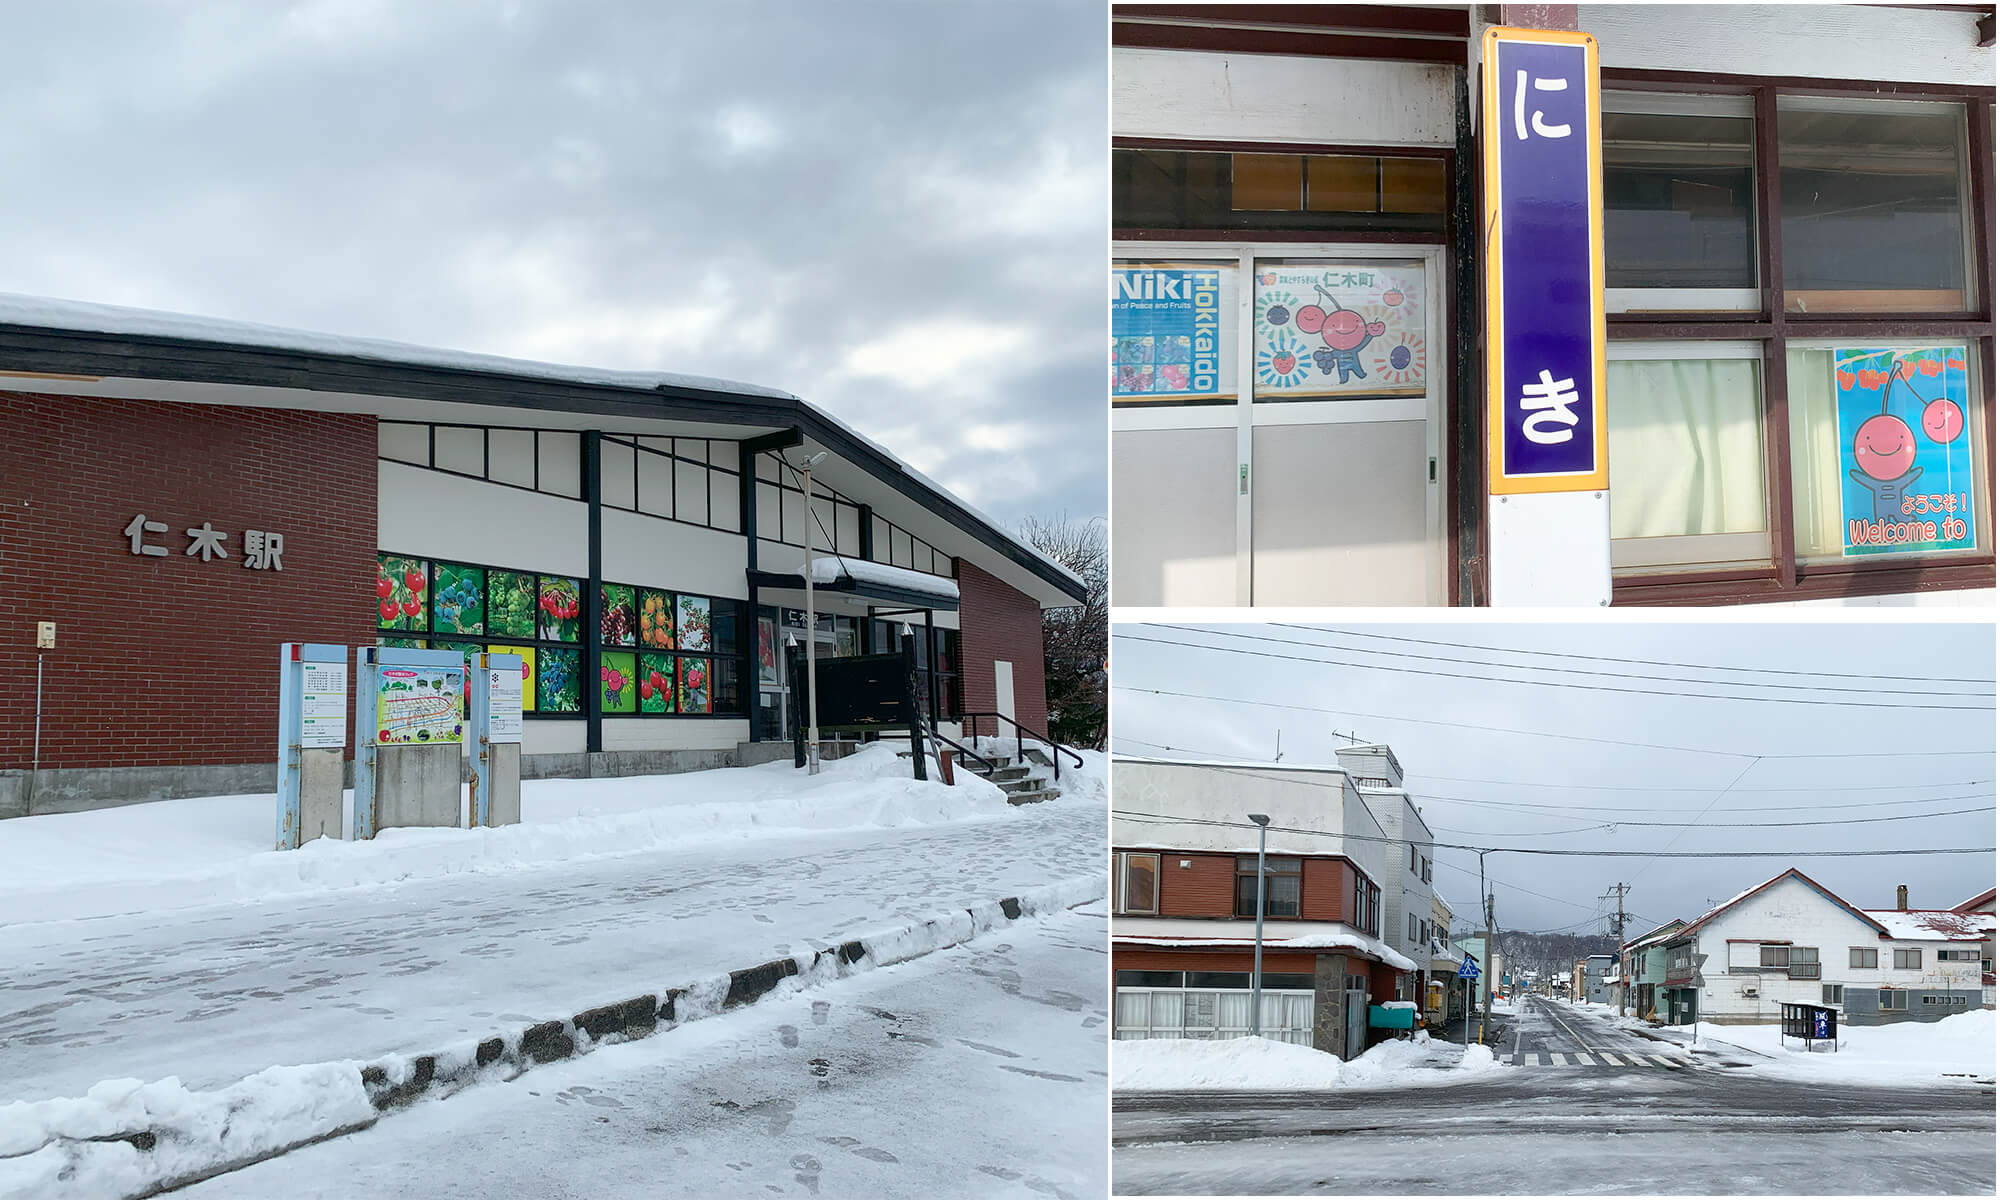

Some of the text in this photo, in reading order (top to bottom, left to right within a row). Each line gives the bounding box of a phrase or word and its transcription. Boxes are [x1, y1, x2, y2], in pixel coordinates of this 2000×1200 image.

[1514, 70, 1579, 444] にき
[1112, 273, 1192, 300] Niki
[1322, 271, 1375, 288] 仁木町
[1194, 274, 1218, 391] Hokkaido
[124, 513, 284, 571] 仁木駅
[1849, 515, 1968, 546] Welcome to
